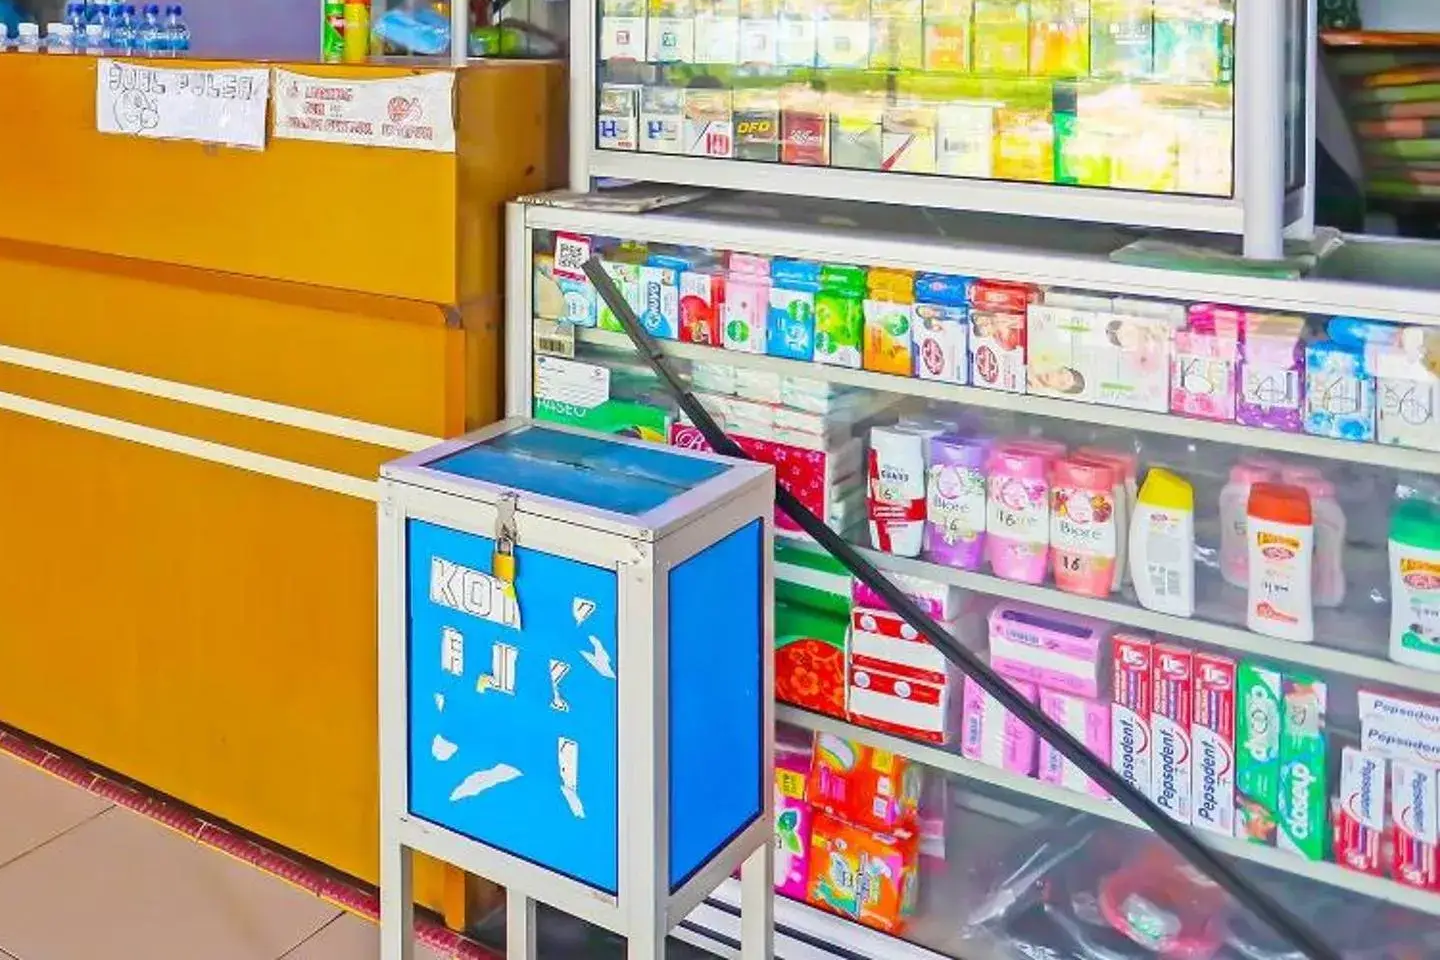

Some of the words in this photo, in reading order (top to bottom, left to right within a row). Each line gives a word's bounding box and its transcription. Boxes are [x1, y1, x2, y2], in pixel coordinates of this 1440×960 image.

[1373, 699, 1440, 725] Pepsoden
[1368, 728, 1440, 754] Pepsoden
[1158, 727, 1175, 810] Pepsodent
[1198, 739, 1216, 823] Pepsodent
